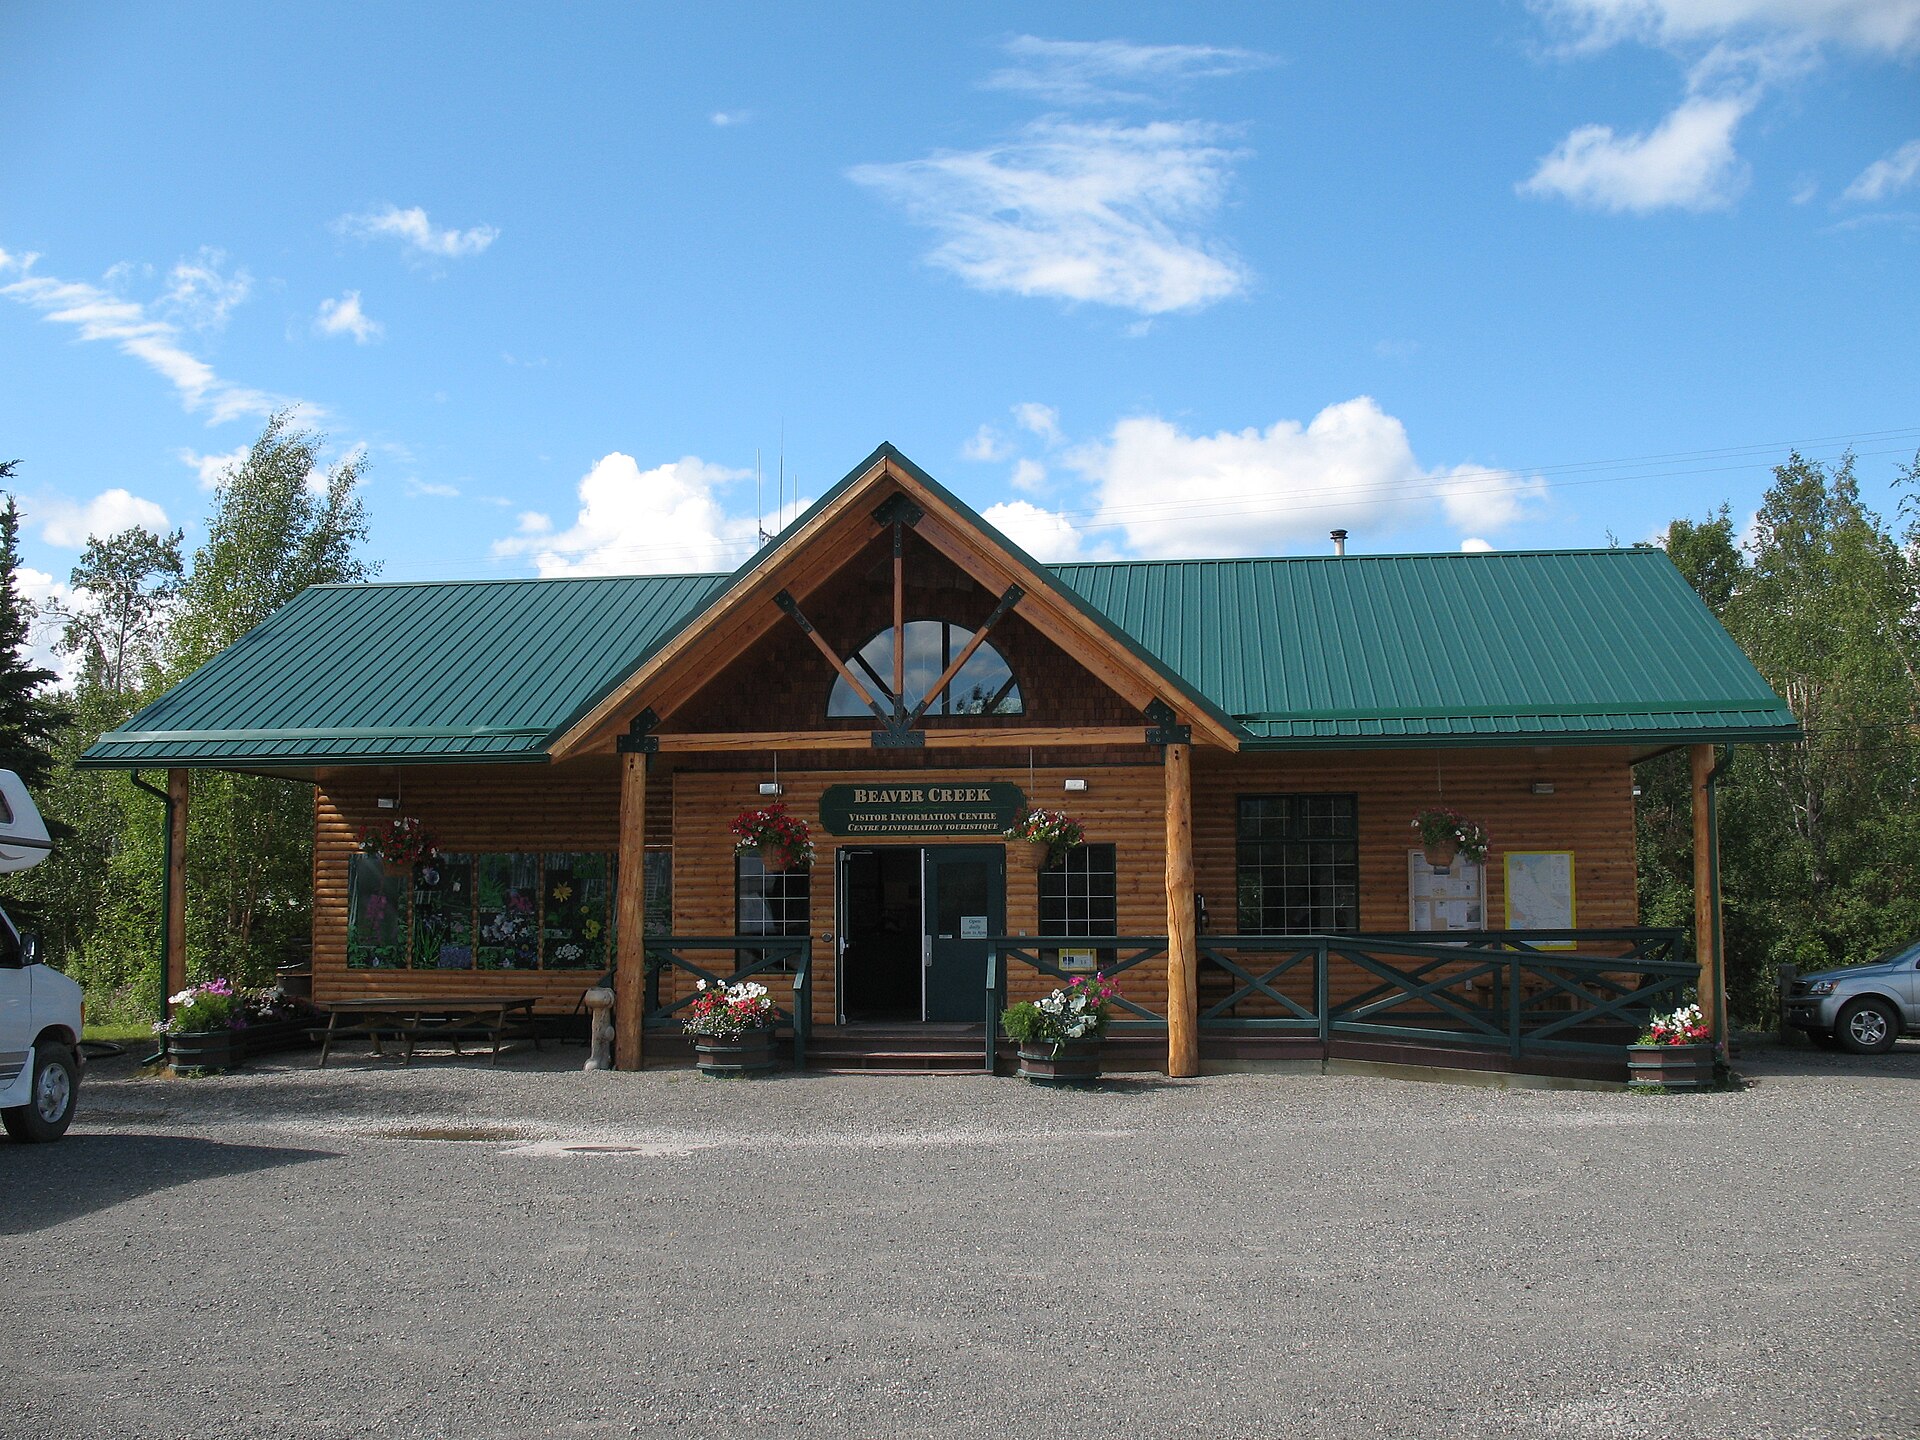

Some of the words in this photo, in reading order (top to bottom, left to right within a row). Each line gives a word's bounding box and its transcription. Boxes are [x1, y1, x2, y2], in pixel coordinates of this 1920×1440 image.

[853, 789, 925, 803] BEAVER
[928, 788, 991, 802] CREEK
[849, 813, 888, 821] VISITOR
[890, 812, 957, 821] INFORMATION
[959, 812, 997, 820] CENTRE
[847, 823, 880, 832] CENTRE
[945, 822, 999, 831] TOURISTIQUE
